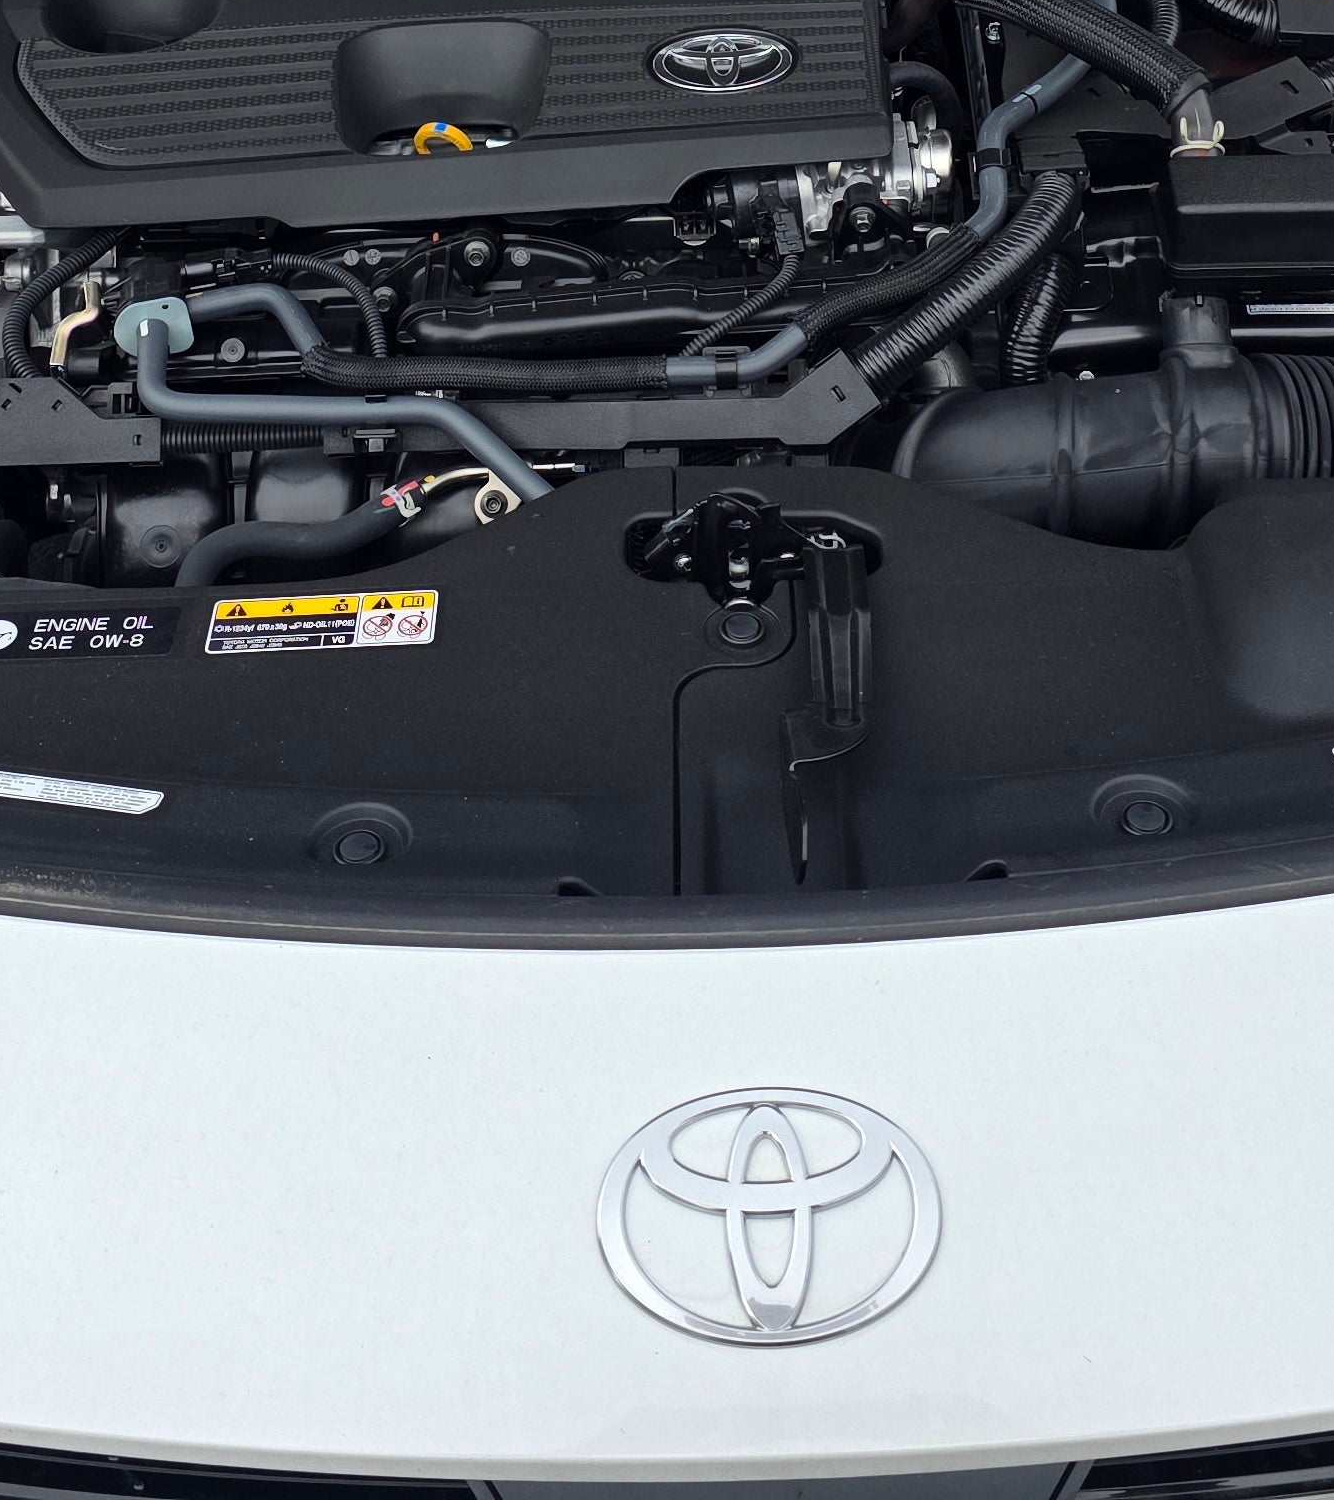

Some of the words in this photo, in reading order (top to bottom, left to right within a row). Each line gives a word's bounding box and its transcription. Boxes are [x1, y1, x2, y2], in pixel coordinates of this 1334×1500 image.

[33, 616, 110, 633] ENGINE
[123, 615, 154, 630] OIL
[28, 635, 76, 651] SAE
